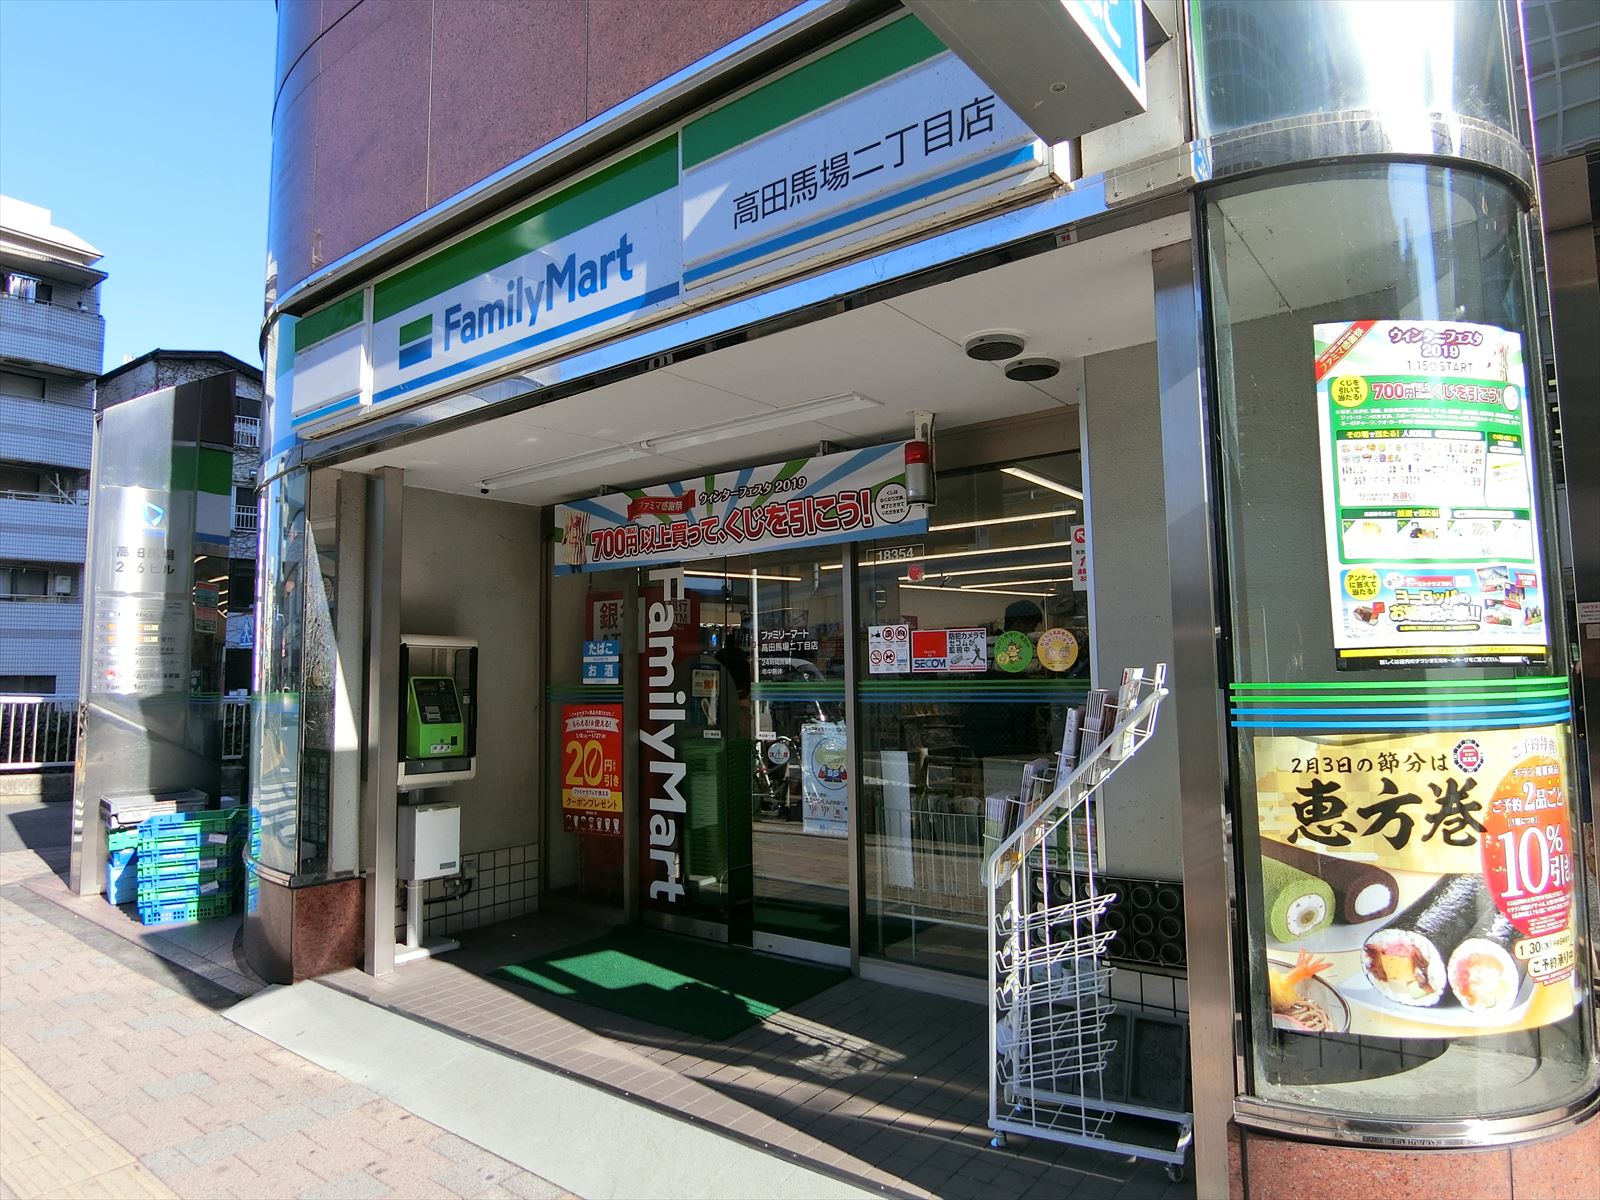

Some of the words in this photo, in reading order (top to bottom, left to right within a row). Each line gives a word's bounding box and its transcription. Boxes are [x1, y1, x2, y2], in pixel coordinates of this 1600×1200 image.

[732, 95, 996, 230] 高田馬場二丁目店
[444, 232, 634, 352] FamilyMart
[1421, 343, 1460, 359] 2019
[1339, 379, 1360, 387] くじを
[1338, 386, 1360, 395] 引いて
[699, 482, 772, 506] ウィンターフェスタ
[774, 476, 808, 493] 2019
[638, 499, 683, 512] ファミマ感謝祭
[591, 489, 875, 561] 700円以上買って、くじを引こう!
[877, 547, 914, 561] 18354
[116, 561, 175, 574] 26ビル
[1347, 573, 1377, 582] アンケート
[1349, 581, 1376, 589] に答えて
[1351, 588, 1377, 596] 当たる!
[761, 628, 810, 641] ファミリーマート
[948, 631, 986, 641] 防犯カメラで
[588, 642, 614, 656] たばこ
[761, 640, 819, 653] 高田馬場二丁目店
[949, 639, 975, 647] セコムが
[949, 646, 971, 655] 監視中
[914, 658, 946, 669] SECOM
[640, 567, 687, 903] FamilyMart
[565, 739, 603, 786] 20
[1291, 752, 1450, 774] 2月3日の節分は
[604, 774, 620, 788] 引き
[566, 797, 619, 811] クーポンプレゼント
[1287, 776, 1488, 851] 恵方巻
